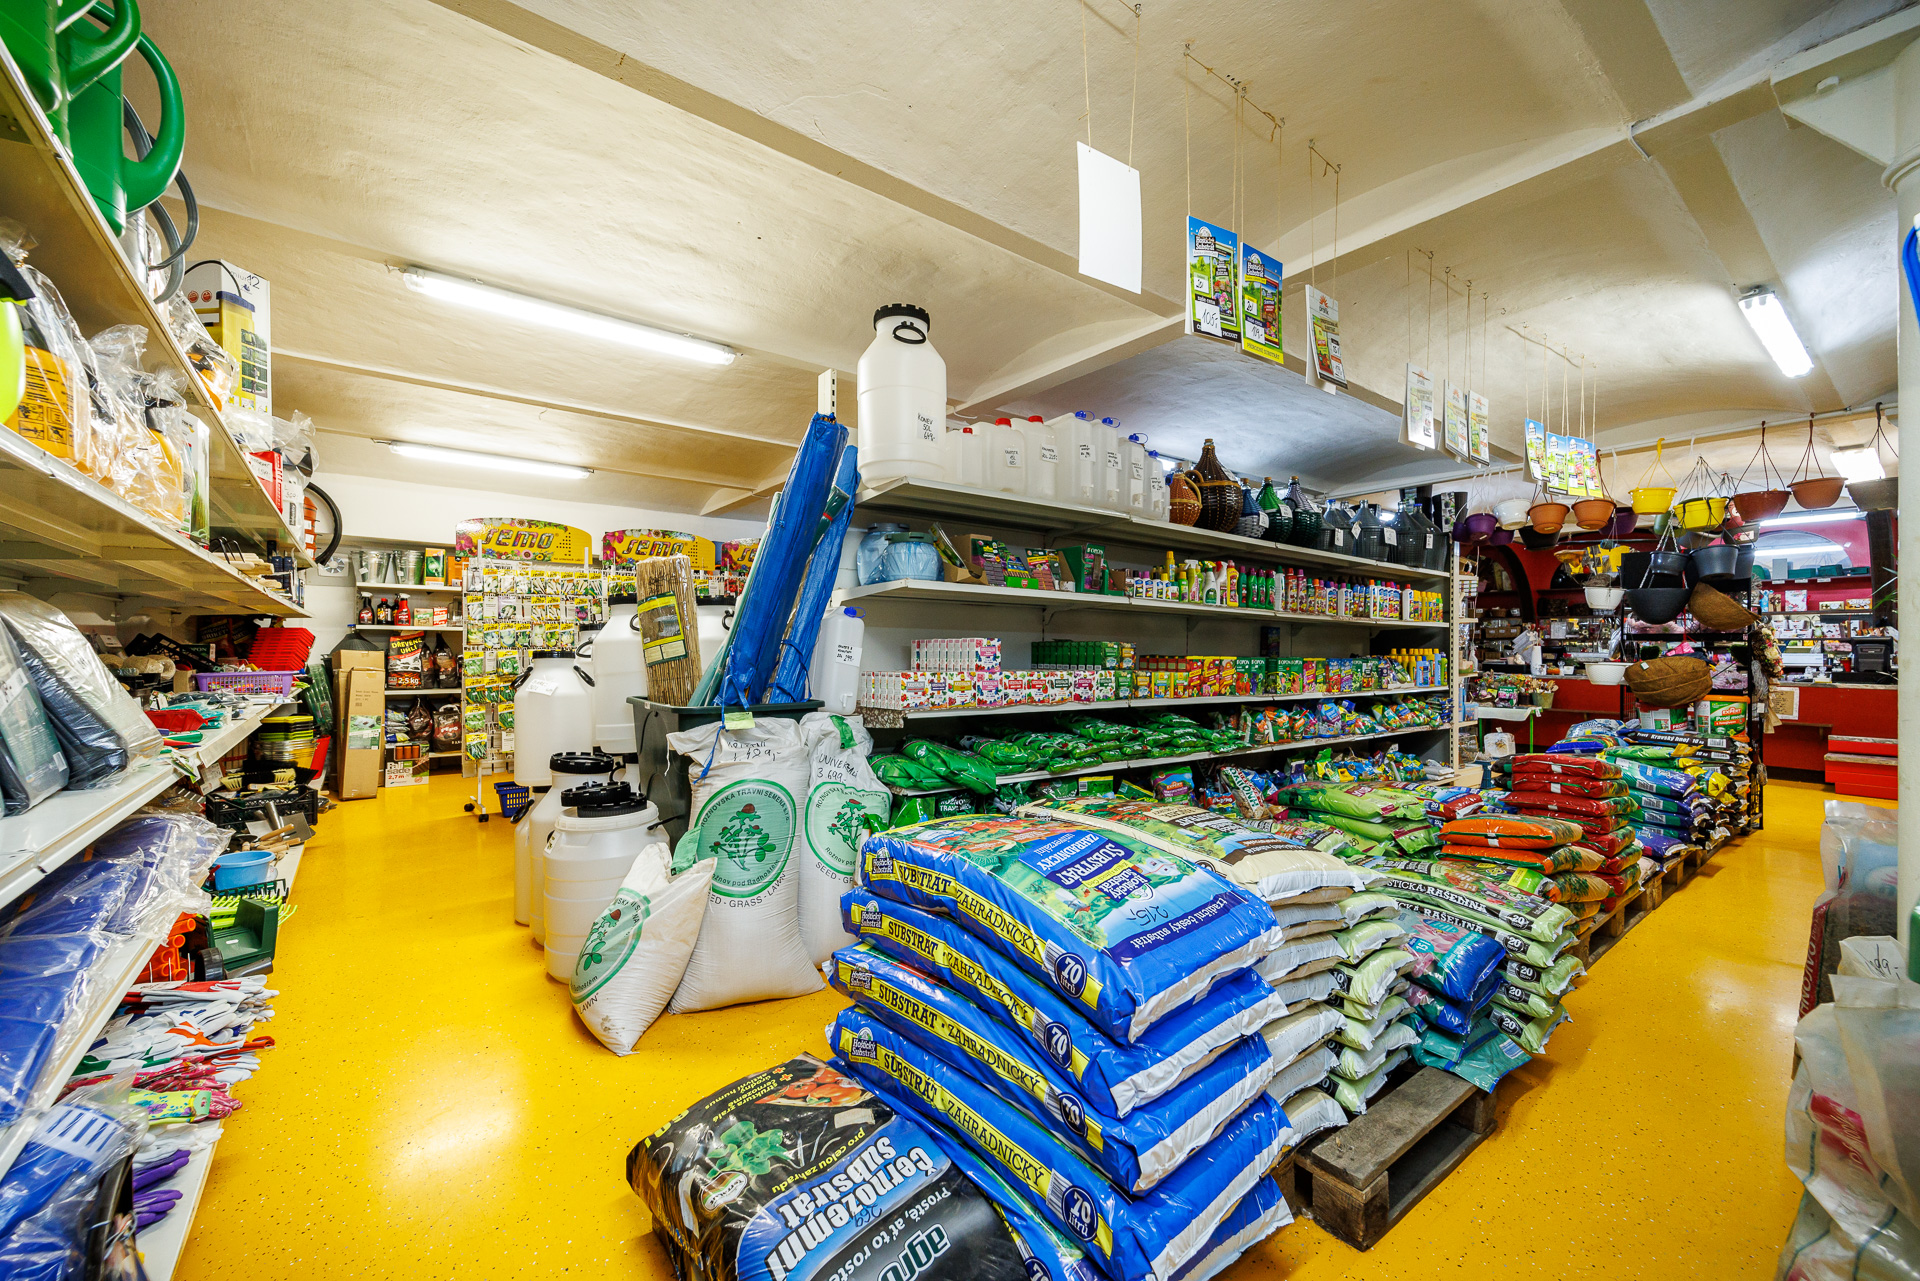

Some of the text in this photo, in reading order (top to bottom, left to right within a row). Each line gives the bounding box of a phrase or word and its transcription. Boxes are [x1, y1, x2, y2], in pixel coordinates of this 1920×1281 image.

[1036, 833, 1100, 871] ZAHRADNICKÝ
[816, 862, 837, 880] SEED
[1056, 842, 1126, 886] SUBSTRÁT
[712, 872, 730, 885] ožnov
[729, 896, 763, 908] GRASS
[898, 864, 1039, 955] SUBSTRÁT ZAHRADNICKÝ
[1126, 904, 1170, 927] 215,-
[1130, 897, 1228, 949] tradiční český substrát
[1424, 907, 1484, 934] RAŠELINA
[1512, 914, 1526, 923] 20
[1508, 936, 1522, 946] 20
[888, 921, 1028, 1022] SUBSTRÁT ZAHRADNICKÝ
[1064, 956, 1083, 980] 70
[1521, 966, 1534, 978] 20
[1509, 985, 1522, 996] 20
[1502, 1017, 1516, 1029] 20
[853, 1038, 876, 1052] Hoštický
[878, 984, 1041, 1092] SUBSTRÁT ZAHRADNICKÝ
[1051, 1028, 1068, 1048] 70
[852, 1048, 876, 1060] Substrát
[704, 1090, 736, 1111] humus
[1062, 1097, 1080, 1124] 70
[884, 1052, 1044, 1188] SUBSTRÁT ZAHRADNICKÝ
[772, 1127, 866, 1194] pro celou zahradu
[779, 1136, 897, 1230] substrát
[906, 1186, 952, 1224] Prostě,
[1070, 1192, 1091, 1224] 70
[889, 1214, 906, 1233] ať
[1068, 1213, 1089, 1238] litrů
[871, 1231, 890, 1251] to
